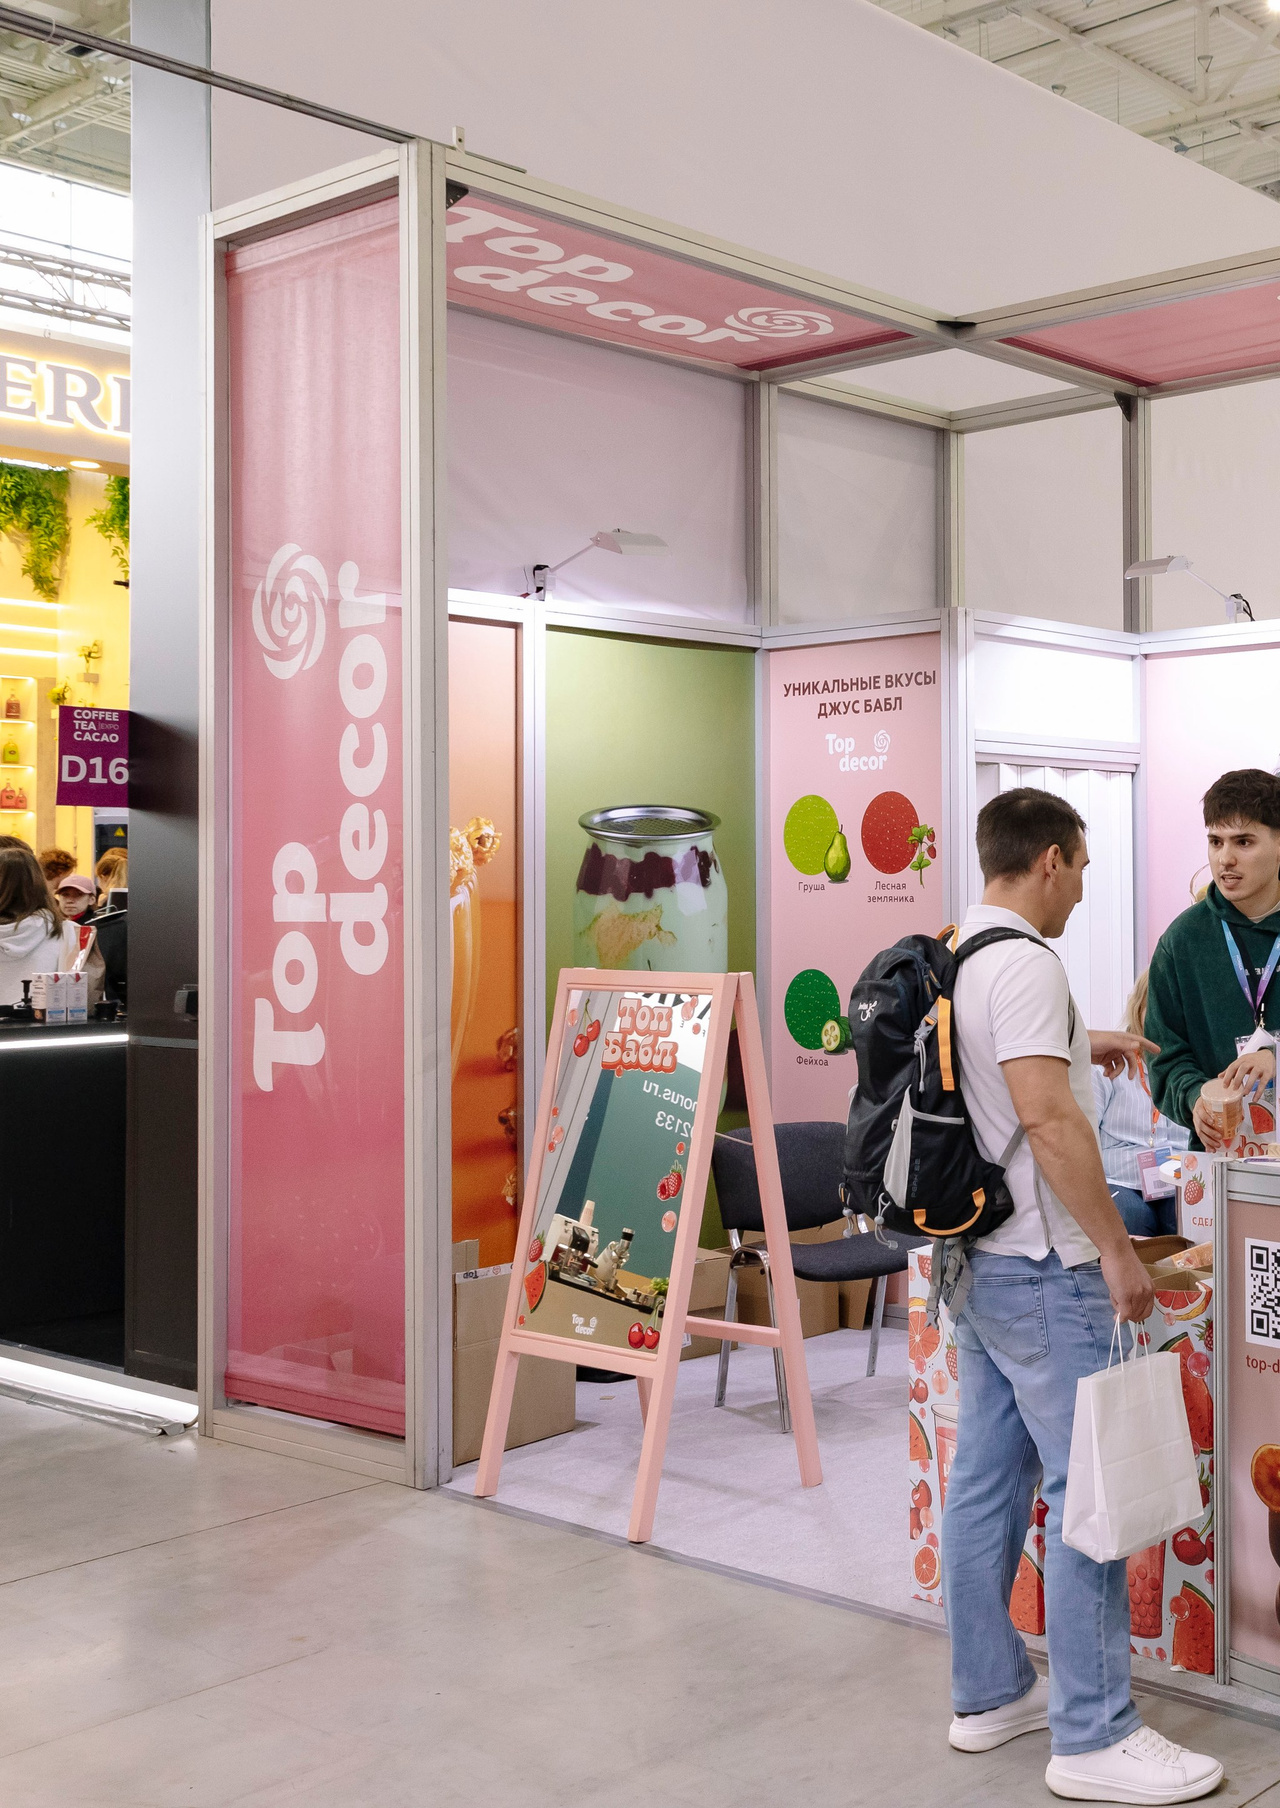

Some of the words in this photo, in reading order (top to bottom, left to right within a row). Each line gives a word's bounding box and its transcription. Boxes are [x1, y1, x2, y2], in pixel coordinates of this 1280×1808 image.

[446, 207, 634, 282] Top
[453, 265, 760, 343] decor
[783, 675, 881, 698] УНИКАЛЬНЫЕ
[884, 670, 937, 689] ВКУСЫ
[73, 709, 119, 721] COFFEE
[817, 700, 860, 720] ДЖУС
[864, 696, 903, 713] БАБЛ
[73, 720, 97, 731] TEA
[100, 723, 119, 731] EXPO
[73, 731, 119, 743] CACAO
[825, 733, 855, 755] Top
[61, 754, 129, 785] D16
[329, 560, 389, 976] decor
[839, 754, 888, 772] decor
[798, 881, 826, 893] Груша
[874, 881, 907, 891] Лесная
[867, 893, 915, 903] земляника
[253, 841, 327, 1092] Top
[618, 998, 672, 1036] Топ
[602, 1031, 678, 1074] Бабл
[796, 1055, 829, 1067] Фейхоа
